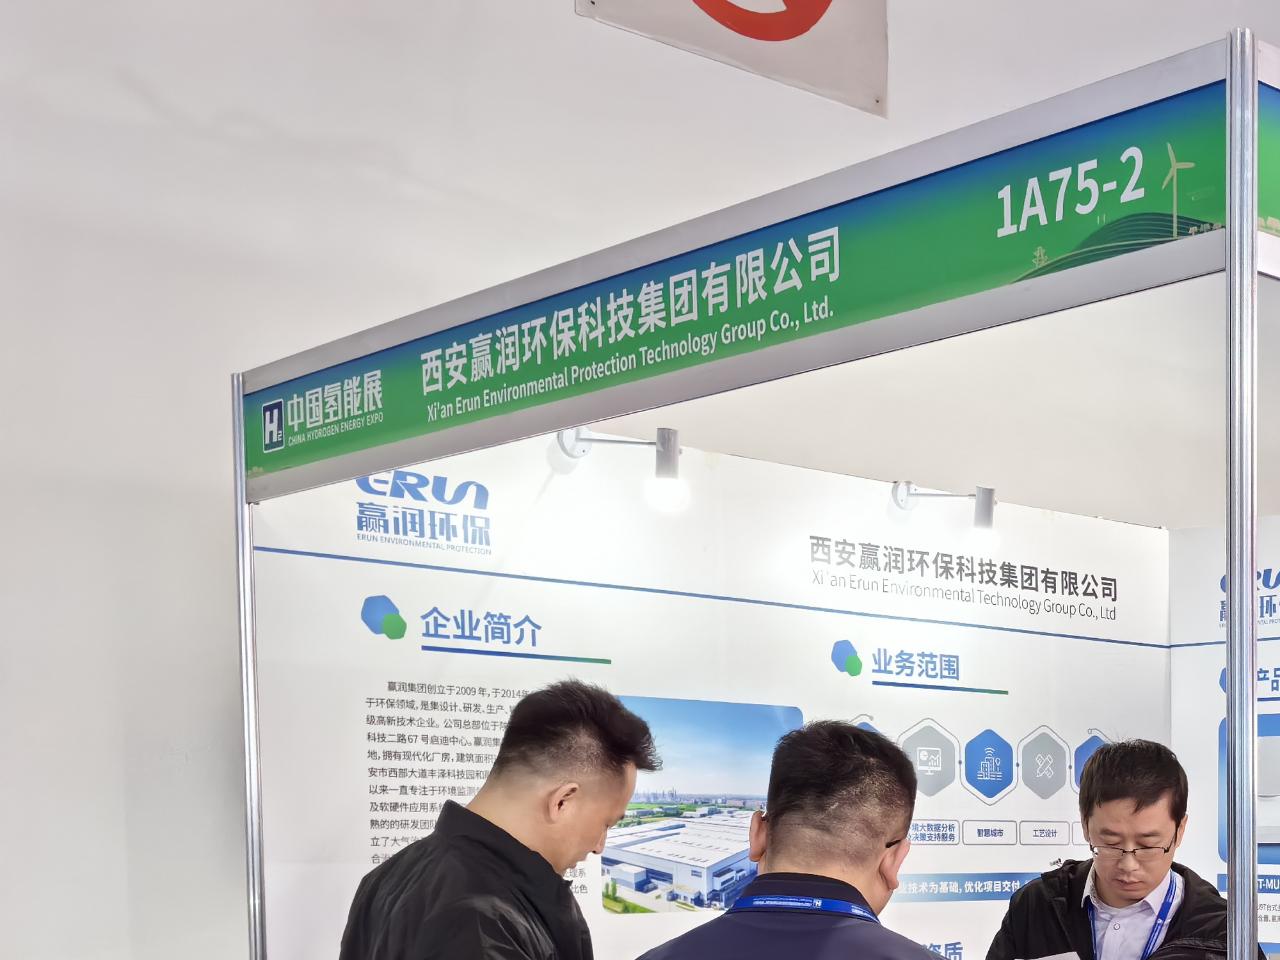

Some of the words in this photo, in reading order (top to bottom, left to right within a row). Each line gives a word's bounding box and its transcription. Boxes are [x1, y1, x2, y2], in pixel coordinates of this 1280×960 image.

[996, 145, 1145, 238] 1A75-2
[420, 226, 841, 396] 西安赢润环保科技集团有限公司
[427, 400, 454, 423] Xi'an
[456, 394, 481, 415] Erun
[483, 366, 569, 407] Environmental
[571, 352, 637, 385] Protection
[639, 330, 718, 366] Technology
[720, 317, 766, 345] Group
[769, 309, 800, 332] Co.,
[803, 295, 834, 325] Ltd.
[287, 369, 383, 433] 中国氢能展
[288, 433, 306, 447] CHINA
[306, 424, 340, 441] HYDROGEN
[340, 416, 365, 432] ENERGY
[366, 411, 384, 426] EXPO
[356, 501, 491, 547] 赢润环保
[357, 533, 379, 543] ERUN
[379, 536, 446, 551] ENVIRONMENTAL
[446, 544, 492, 556] PROTECTION
[809, 535, 1118, 602] 西安赢润环保科技集团有限公司
[849, 574, 879, 592] Erun
[882, 578, 975, 603] Environmental
[977, 589, 1042, 615] Technology
[1044, 599, 1077, 618] Group
[1078, 602, 1099, 620] Co.,
[1100, 605, 1116, 620] Ltd
[420, 606, 542, 647] 企业简介
[871, 647, 960, 681] 业务范围
[1032, 829, 1058, 838] 工艺设计
